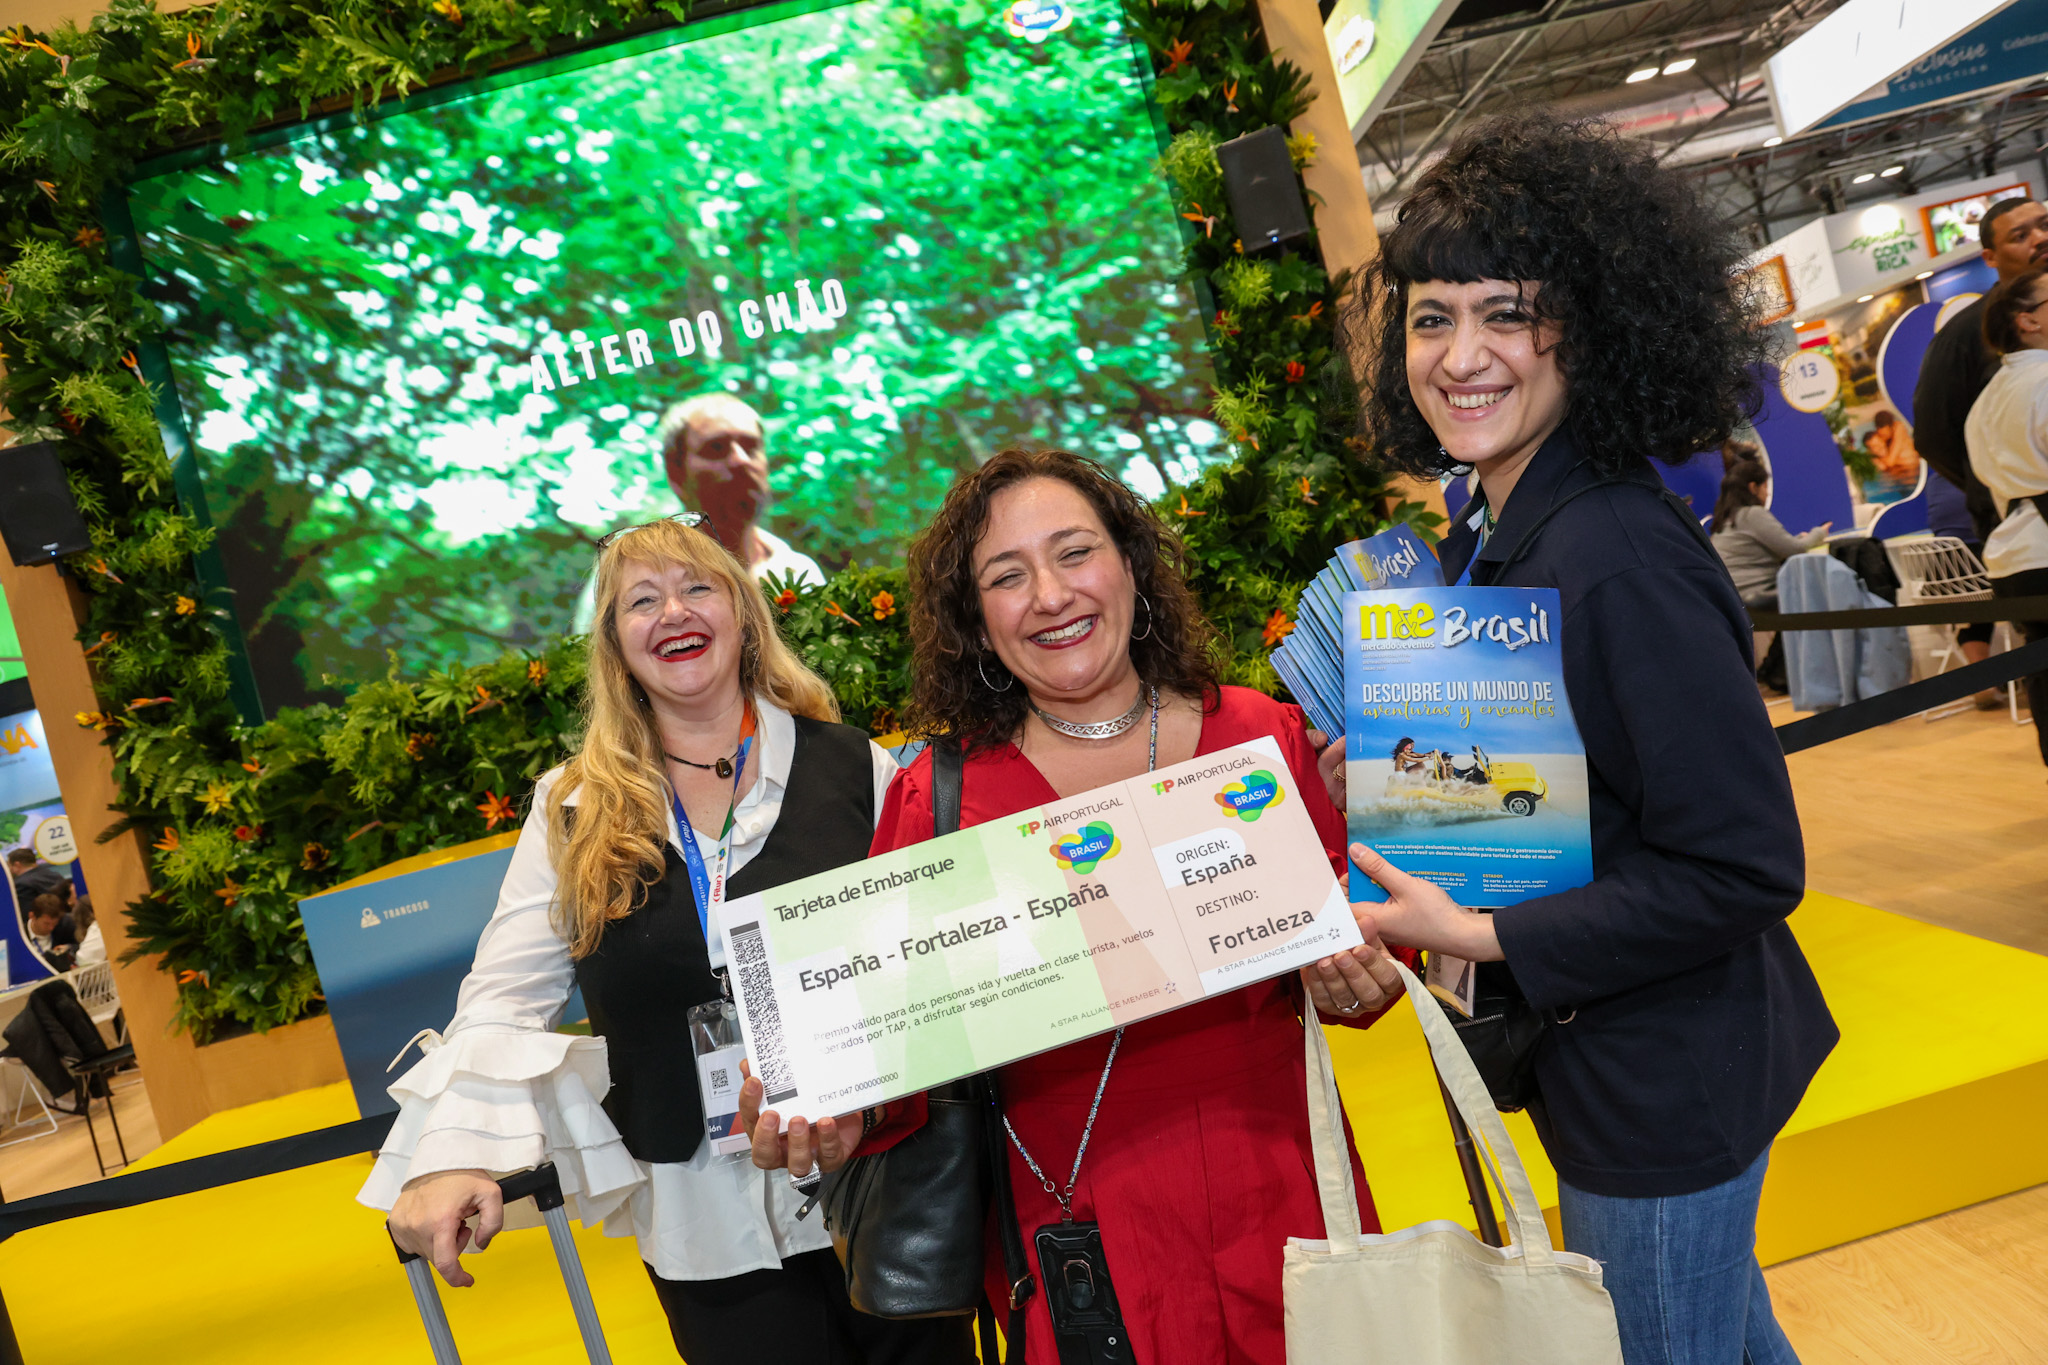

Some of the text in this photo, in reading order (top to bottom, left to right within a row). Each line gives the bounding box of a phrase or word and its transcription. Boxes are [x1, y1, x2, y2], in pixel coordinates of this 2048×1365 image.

[1873, 240, 1918, 260] COSTA
[1877, 255, 1909, 272] RICA
[530, 278, 848, 394] ALTER DO CHÃO
[1800, 362, 1818, 378] 13
[1371, 537, 1421, 585] Brasil
[1360, 601, 1550, 651] m&e Brasil
[1363, 681, 1553, 703] DESCUBRE UN MUNDO DE
[1363, 699, 1555, 729] aventuras y encantos
[1150, 779, 1175, 796] TAP
[1233, 789, 1271, 807] BRASIL
[48, 826, 65, 839] 22
[1016, 820, 1041, 838] TAP
[1069, 840, 1107, 858] BRASIL
[1176, 839, 1230, 864] ORIGEN:
[1181, 854, 1257, 887] España
[774, 858, 955, 922] Tarjeta de Embarque
[1196, 889, 1259, 917] DESTINO:
[799, 953, 881, 992] España
[900, 915, 1008, 960] Fortaleza
[1027, 883, 1109, 920] España
[1208, 910, 1315, 954] Fortaleza
[1224, 961, 1245, 973] STAR
[1247, 948, 1286, 966] ALLIANCE
[1287, 934, 1325, 951] MEMBER
[852, 1015, 882, 1031] válido
[884, 1008, 907, 1022] para
[908, 1001, 927, 1013] dos
[930, 986, 975, 1008] personas
[978, 979, 994, 991] ida
[995, 977, 1001, 988] y
[1004, 966, 1036, 983] vuelta
[1039, 961, 1051, 972] en
[1054, 951, 1080, 967] clase
[1082, 940, 1120, 958] turista,
[1121, 928, 1154, 945] vuelos
[820, 974, 1064, 1055] perados por TAP, a disfrutar según condiciones.
[1057, 1015, 1079, 1027] STAR
[1081, 1002, 1121, 1020] ALLIANCE
[1122, 989, 1161, 1005] MEMBER
[818, 1092, 837, 1104] ETKT
[839, 1086, 853, 1097] 047
